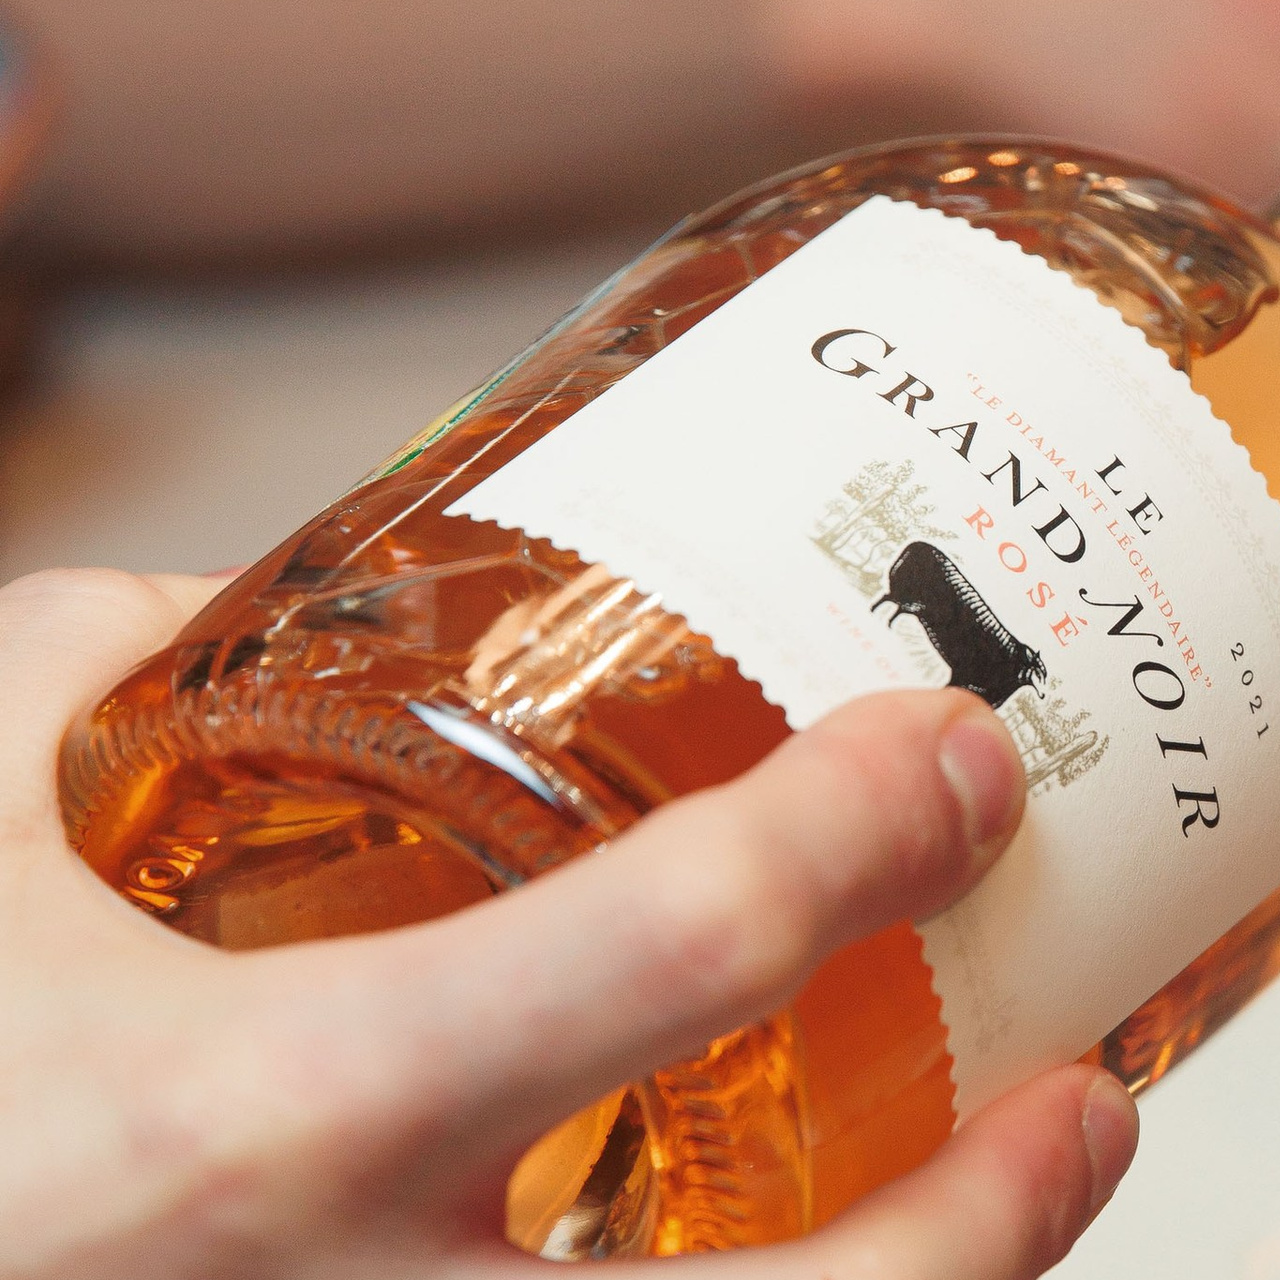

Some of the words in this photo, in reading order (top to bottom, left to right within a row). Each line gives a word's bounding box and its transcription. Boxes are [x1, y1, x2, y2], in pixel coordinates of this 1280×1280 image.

[1005, 411, 1108, 515] DIAMANT
[1094, 453, 1164, 536] LE
[811, 328, 1087, 564] GRAND
[1078, 587, 1222, 839] NOIR
[961, 504, 1089, 648] ROSÉ
[1230, 642, 1270, 739] 2021
